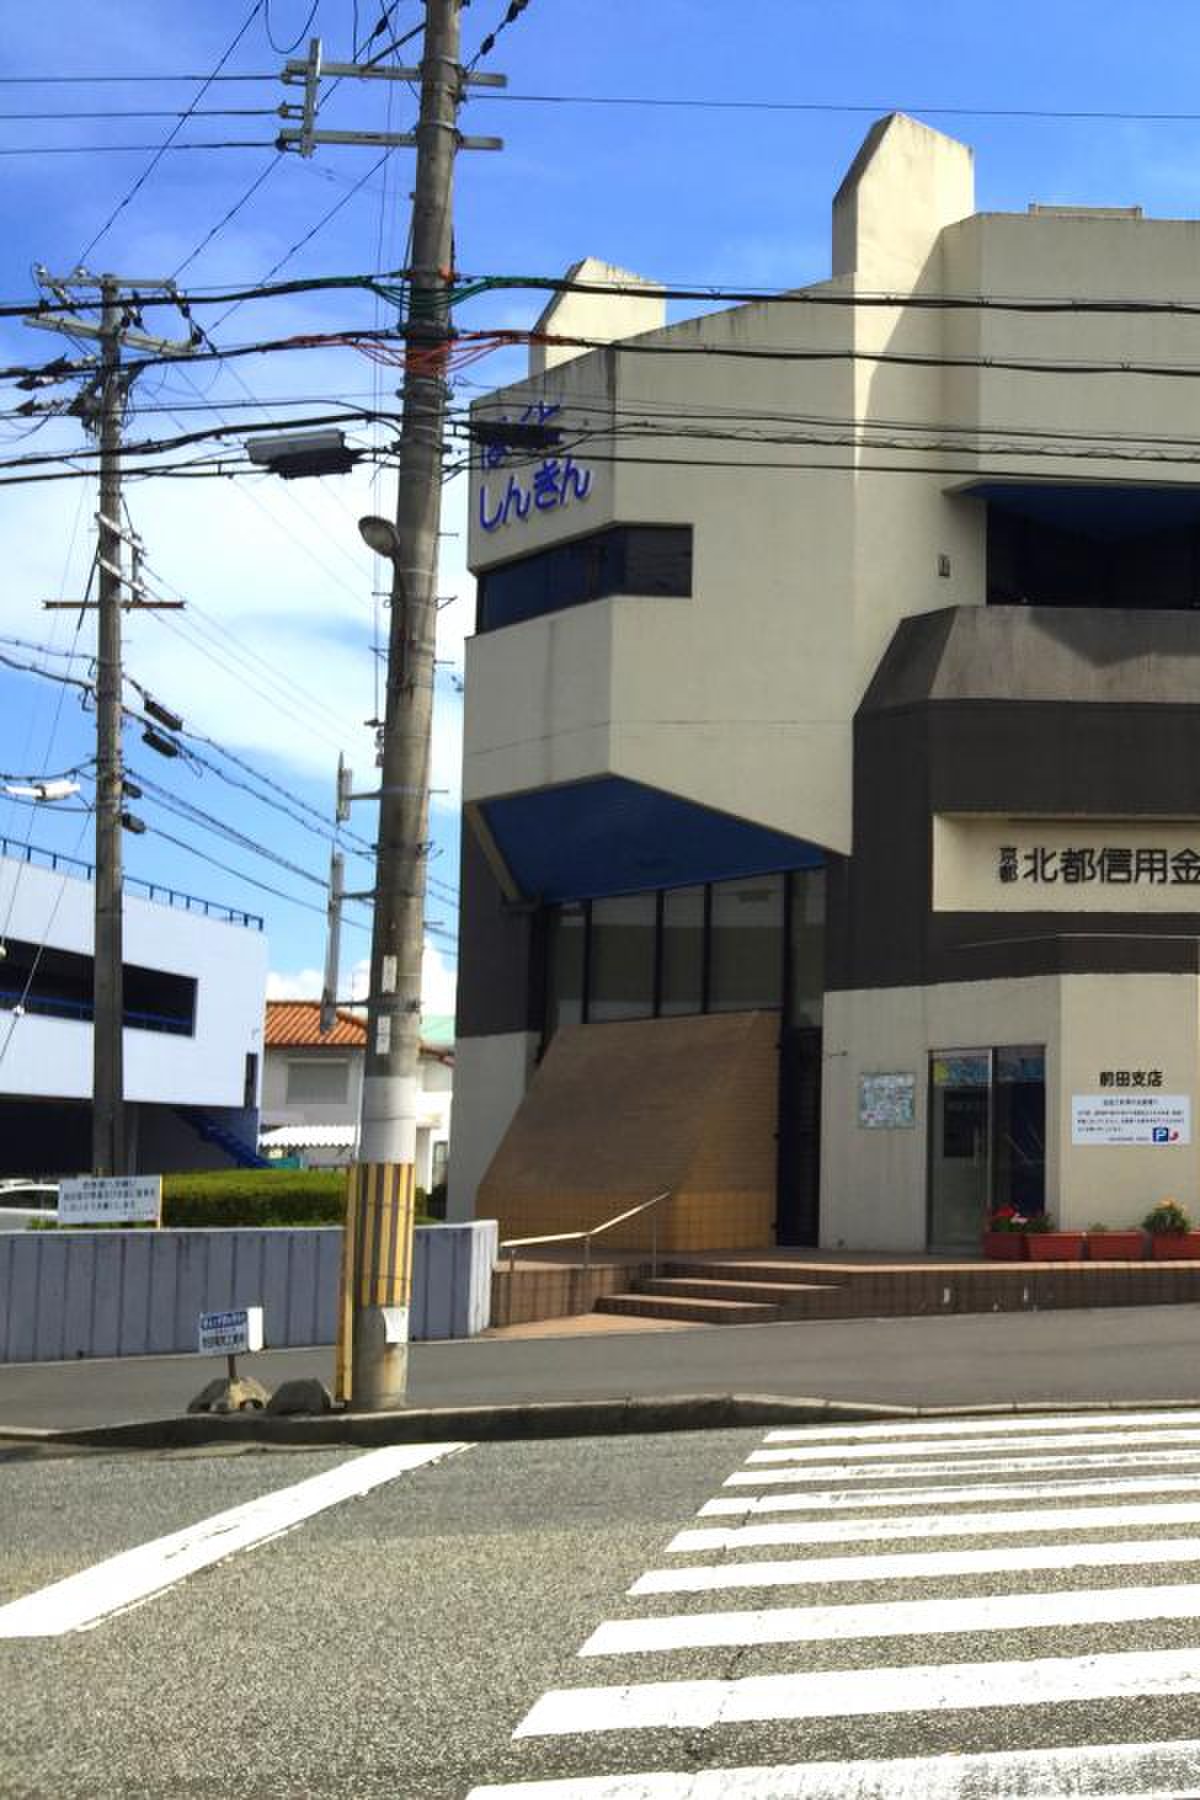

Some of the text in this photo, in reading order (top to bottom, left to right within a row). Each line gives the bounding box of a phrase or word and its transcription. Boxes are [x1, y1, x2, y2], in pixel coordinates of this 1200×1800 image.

[479, 454, 591, 532] しんきん
[1099, 1071, 1163, 1087] 前田支店
